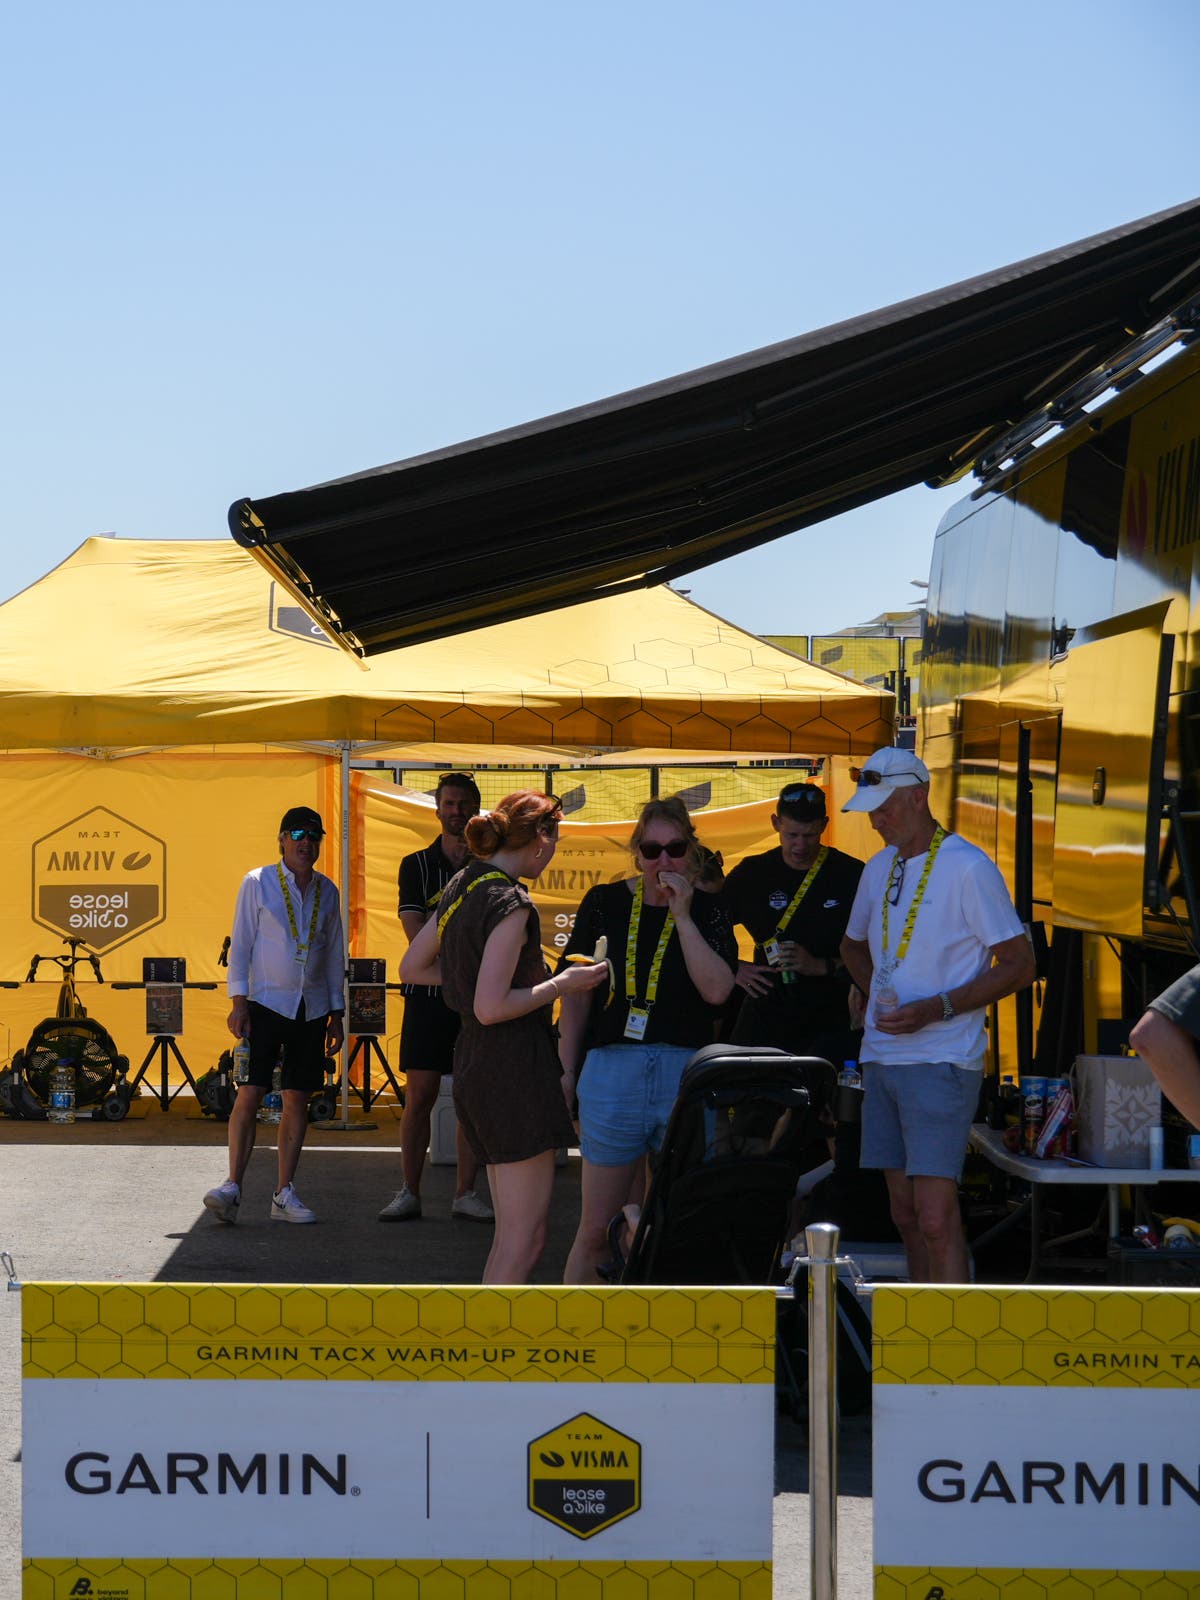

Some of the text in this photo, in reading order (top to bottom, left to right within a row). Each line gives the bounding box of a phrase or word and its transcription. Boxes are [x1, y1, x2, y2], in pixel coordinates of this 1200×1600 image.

[196, 1345, 596, 1363] GARMIN TACX WARM-UP ZONE
[1053, 1352, 1159, 1369] GARMIN
[571, 1449, 629, 1468] VISMA
[917, 1459, 1200, 1506] GARMIN
[562, 1486, 605, 1501] lease
